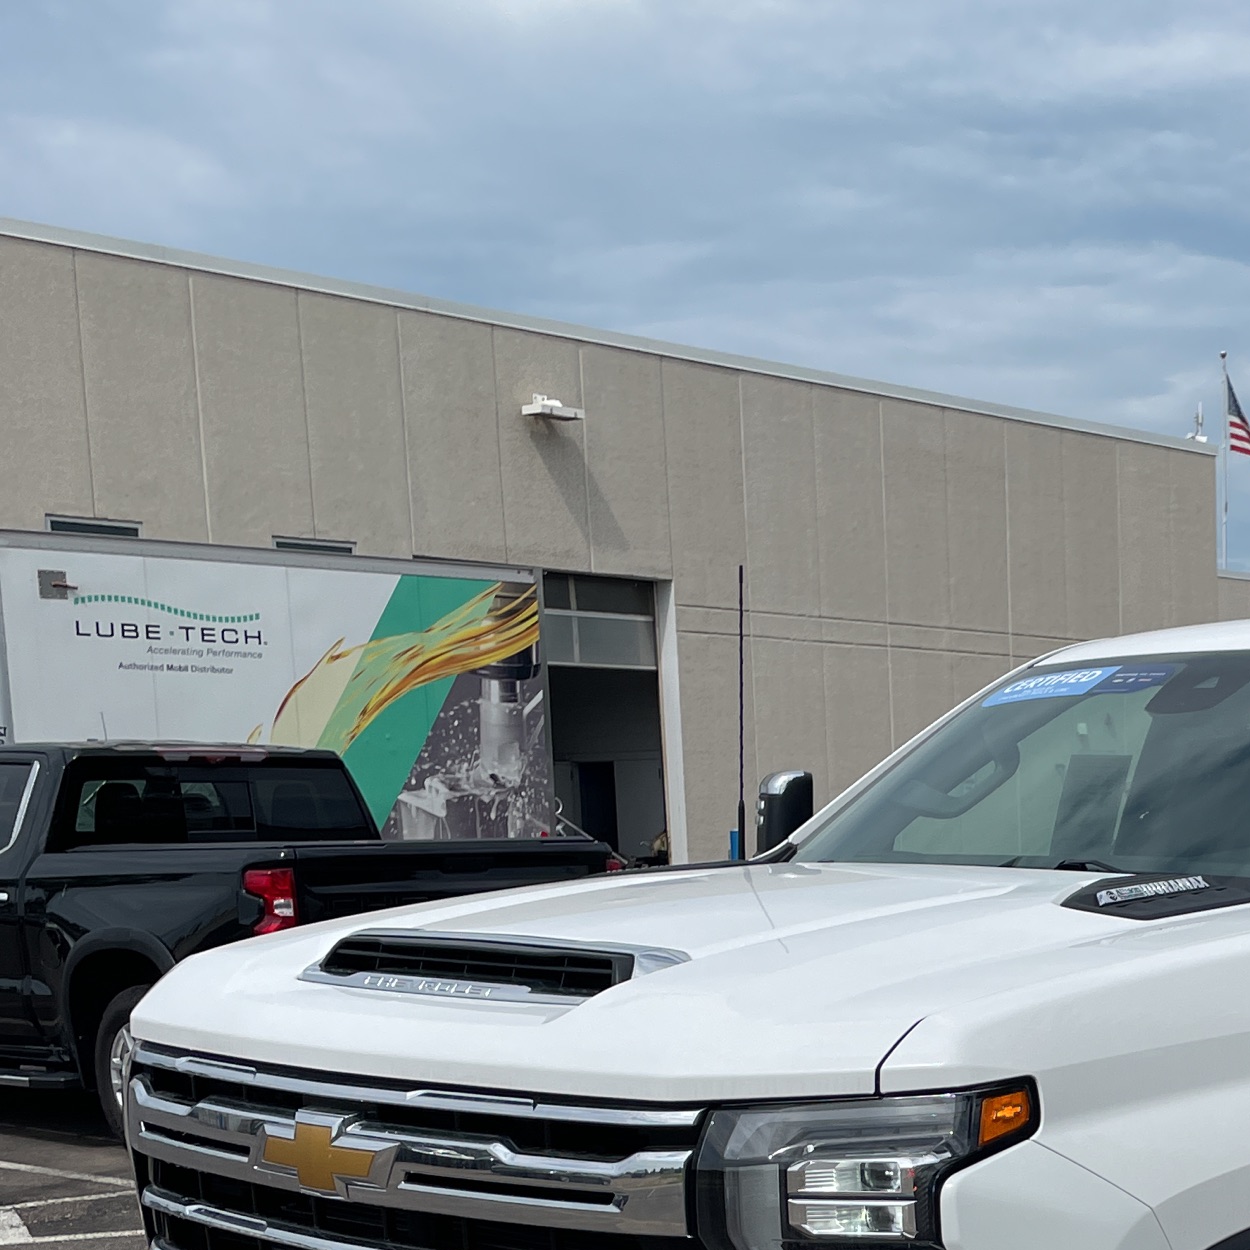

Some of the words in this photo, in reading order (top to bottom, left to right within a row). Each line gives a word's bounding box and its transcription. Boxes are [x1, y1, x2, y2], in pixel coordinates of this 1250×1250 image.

[146, 645, 204, 658] Accelerating
[206, 648, 263, 659] Performance
[118, 662, 164, 672] Authorized
[166, 664, 189, 672] Mobil
[190, 664, 234, 674] Distributor
[1003, 670, 1103, 693] CERTIFIED
[1140, 876, 1210, 897] DURAMAX
